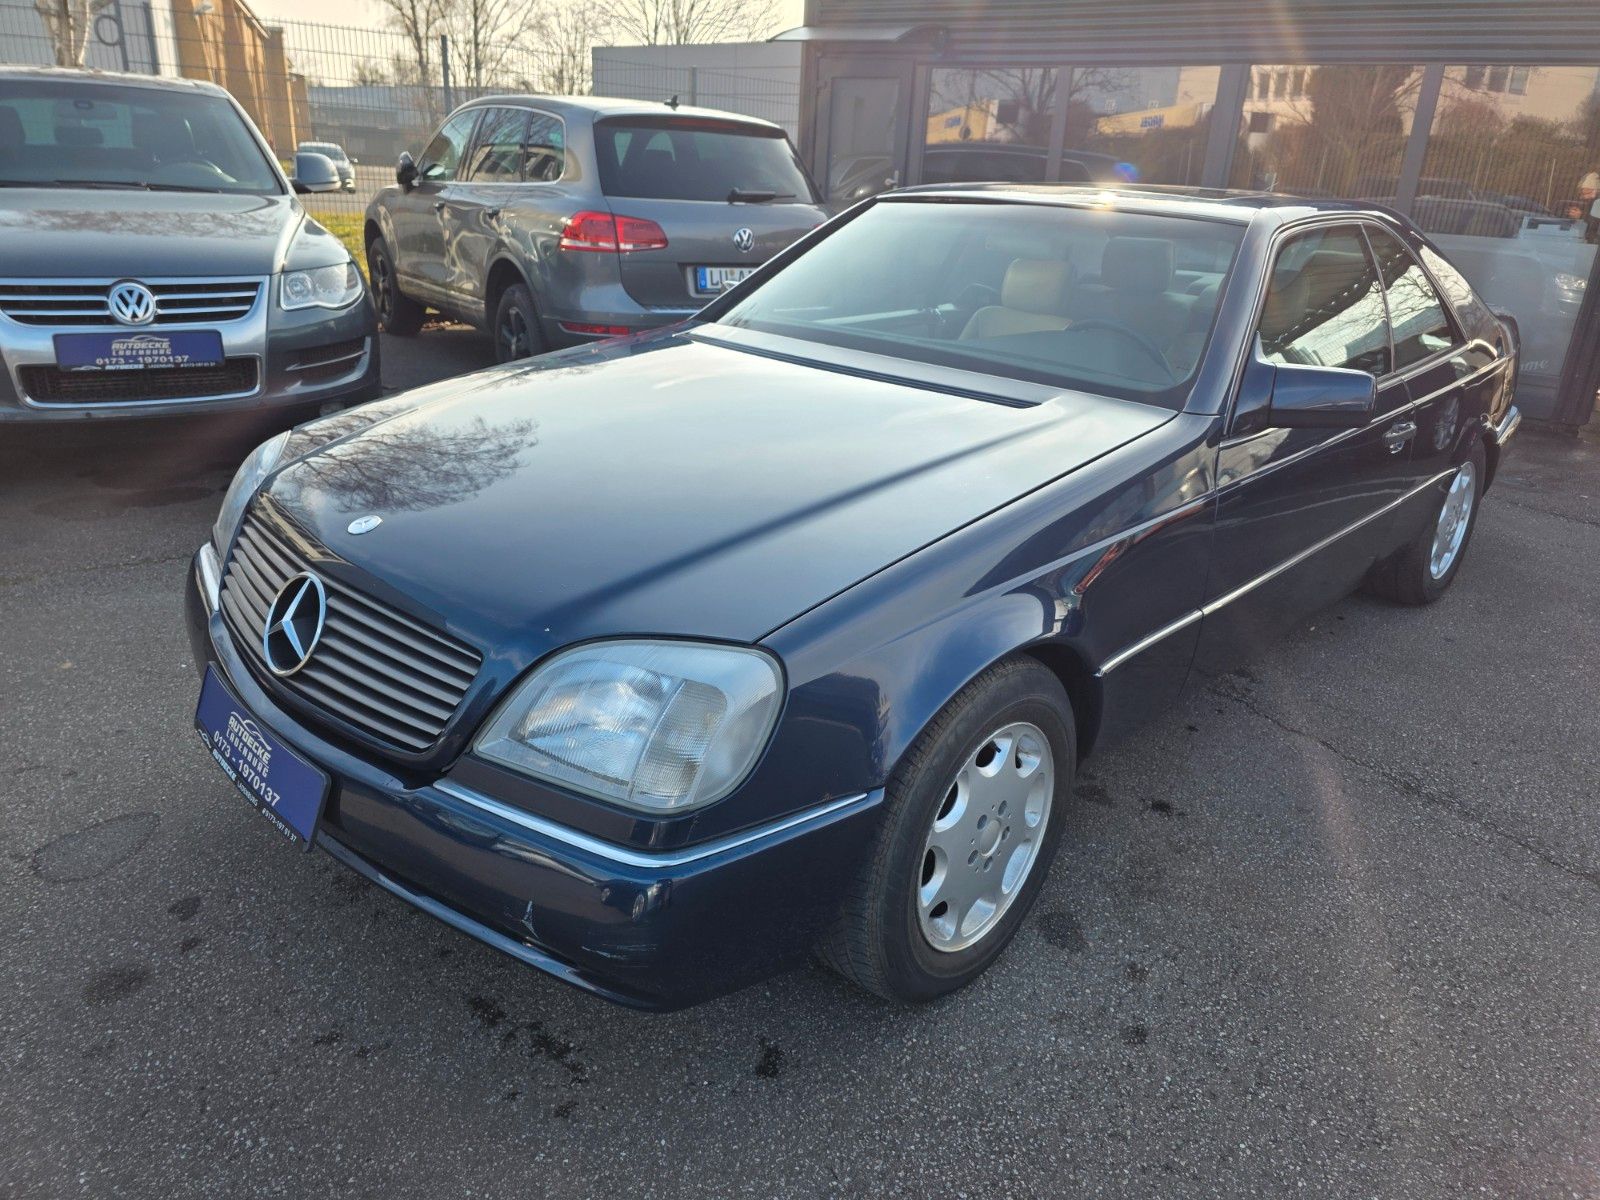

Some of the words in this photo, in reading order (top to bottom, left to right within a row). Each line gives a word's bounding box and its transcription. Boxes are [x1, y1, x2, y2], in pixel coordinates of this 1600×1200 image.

[111, 341, 171, 349] AUTOECKE
[137, 355, 189, 363] 1970137
[226, 730, 269, 778] LADENBURG
[228, 716, 272, 764] AUTOECKE
[213, 730, 231, 758] 0173
[238, 759, 281, 807] 1970137
